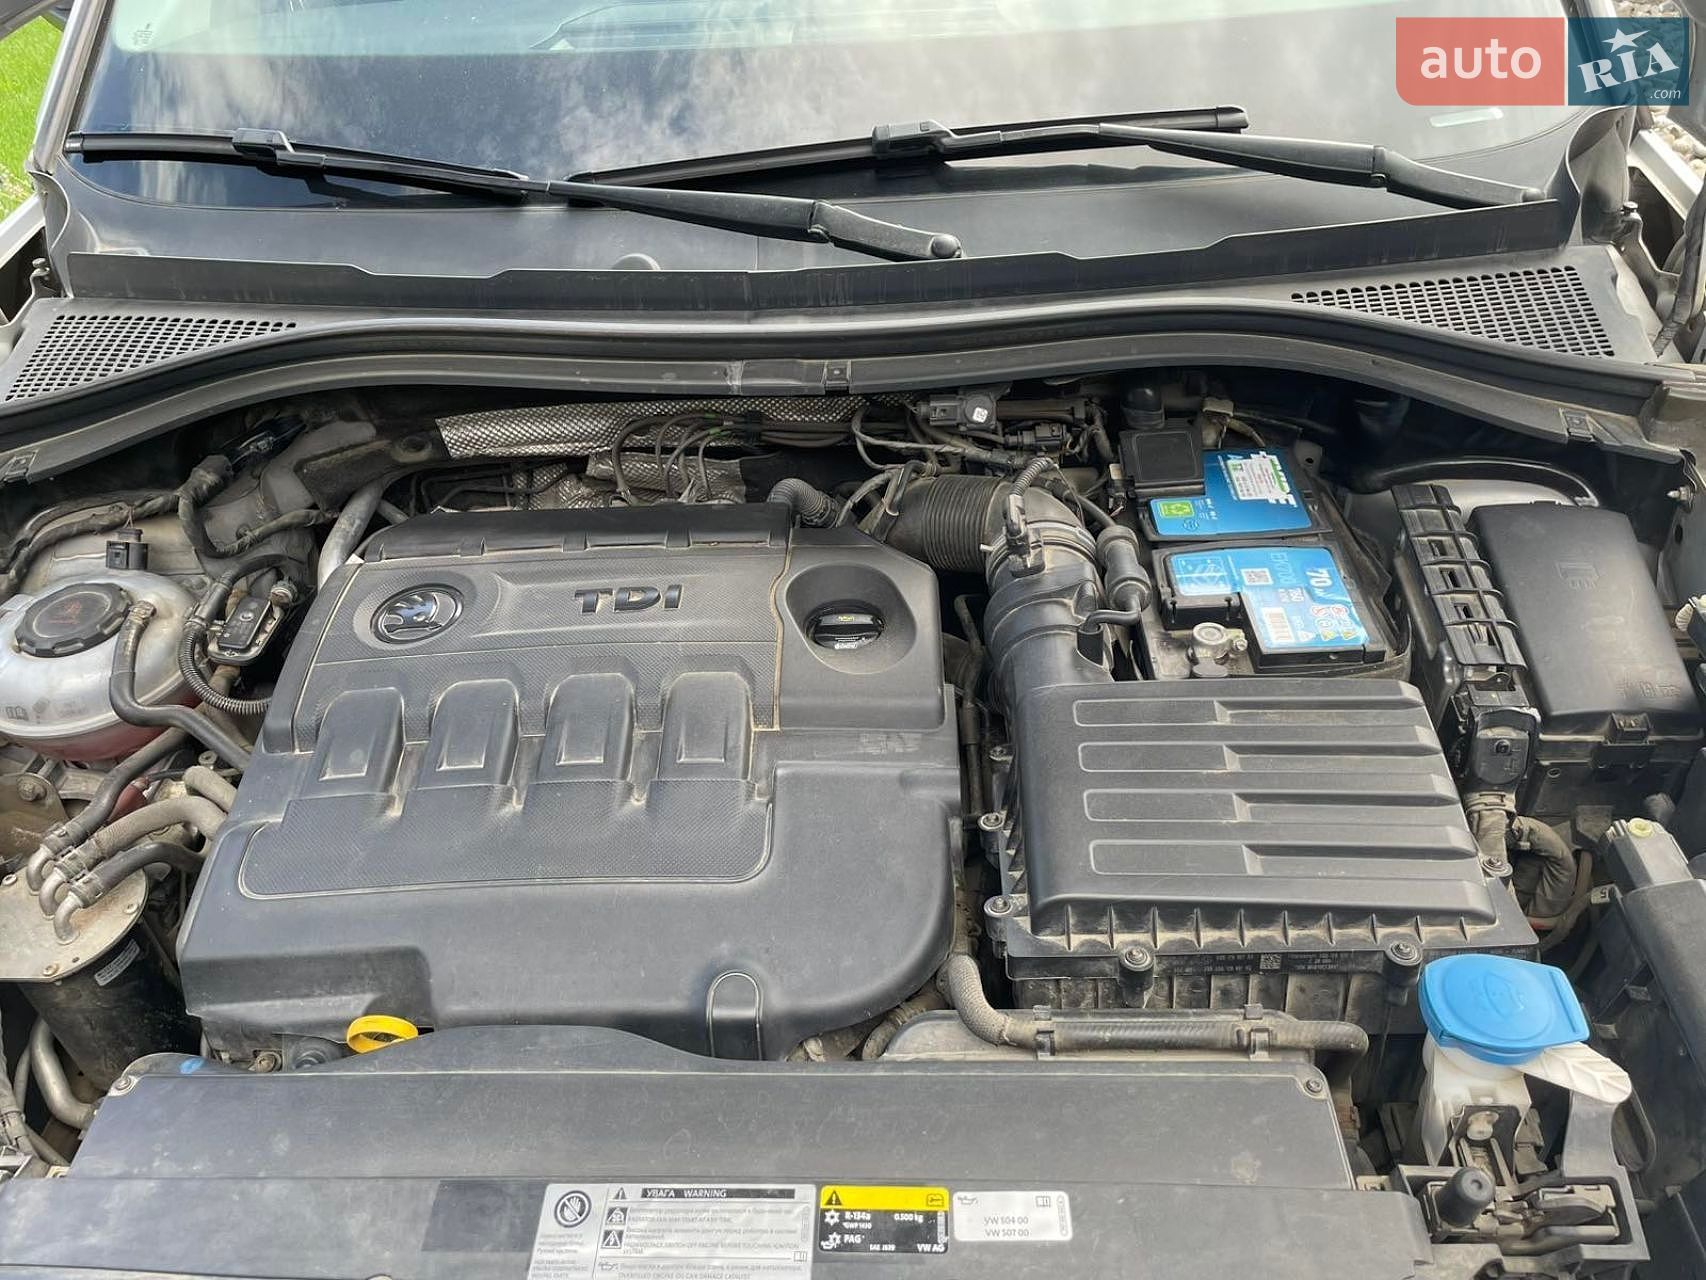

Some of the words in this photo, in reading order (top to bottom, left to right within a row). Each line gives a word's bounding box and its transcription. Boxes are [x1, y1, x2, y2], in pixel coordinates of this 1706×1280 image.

[1306, 568, 1333, 588] 70
[574, 584, 682, 613] TDI
[646, 1188, 676, 1198] УВАГА
[683, 1188, 727, 1198] WARNING
[983, 1215, 999, 1225] VW
[984, 1228, 1000, 1238] VW
[916, 1243, 931, 1252] VW
